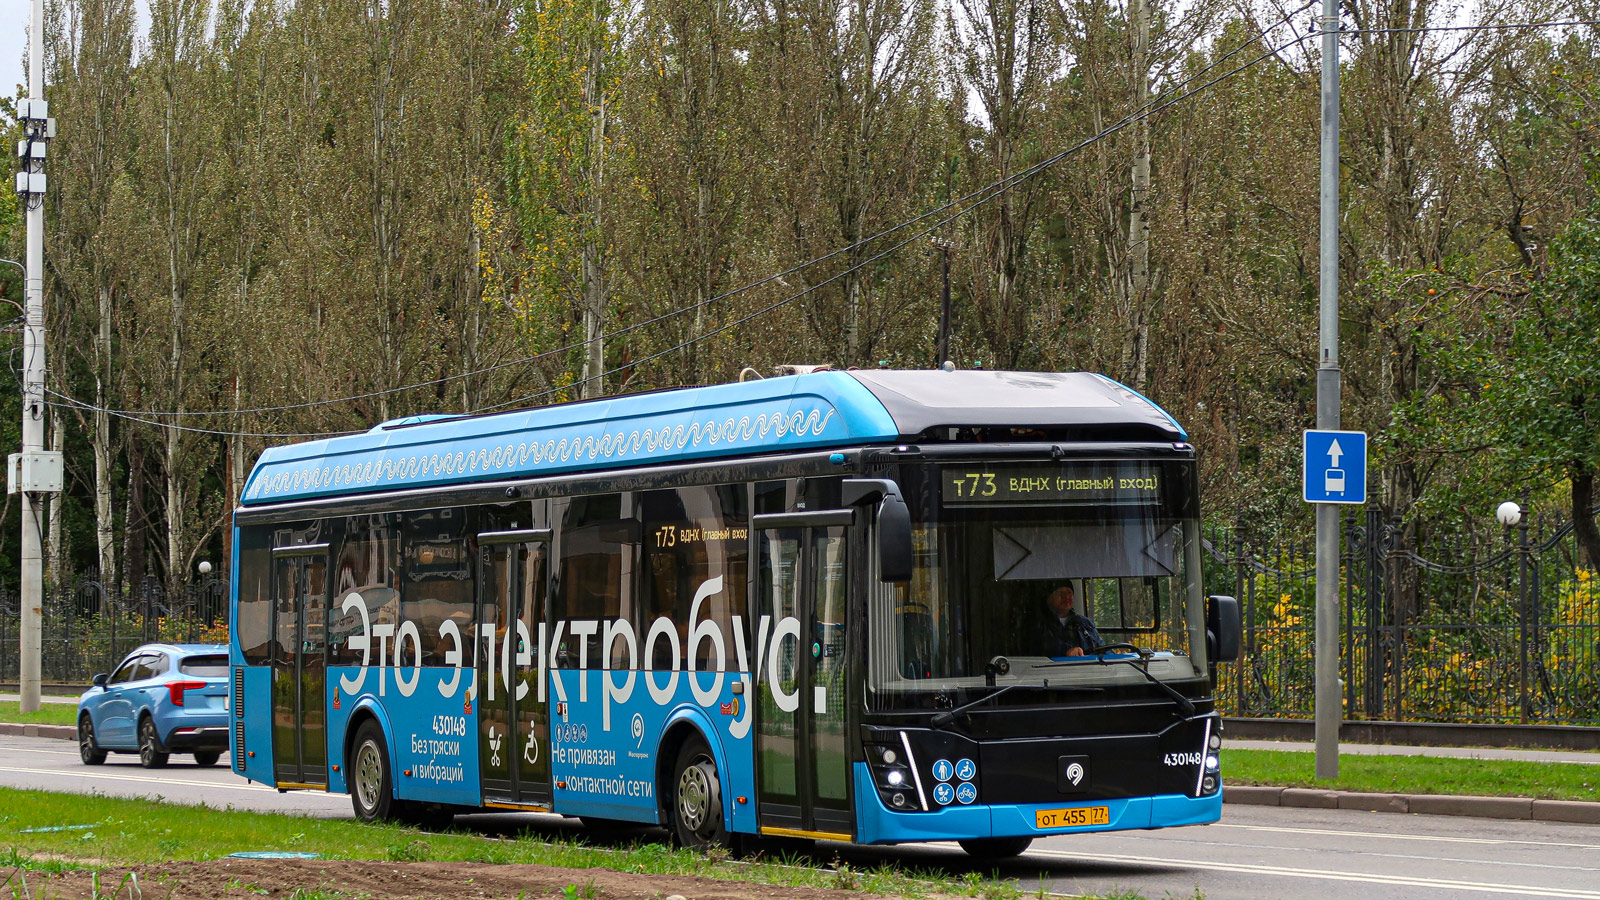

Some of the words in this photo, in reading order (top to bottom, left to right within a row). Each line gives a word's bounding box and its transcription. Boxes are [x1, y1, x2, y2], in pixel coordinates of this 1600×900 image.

[1009, 477, 1050, 493] ВДНХ
[1056, 475, 1114, 491] (главный
[1119, 474, 1158, 490] вход)
[680, 528, 700, 543] ВДНХ
[701, 527, 730, 541] (главный
[339, 592, 422, 697] Это
[437, 574, 827, 739] электробус.
[432, 715, 466, 736] 430148
[411, 733, 428, 754] Без
[429, 739, 460, 759] тряски
[551, 742, 566, 763] Не
[568, 747, 616, 769] привязан
[1163, 752, 1202, 766] 430148
[412, 764, 419, 778] и
[419, 759, 464, 784] вибраций
[552, 775, 560, 790] к
[565, 774, 626, 796] контактной
[627, 780, 653, 798] сети
[1042, 815, 1057, 826] ОТ
[1063, 810, 1086, 824] 455
[1092, 808, 1105, 819] 77
